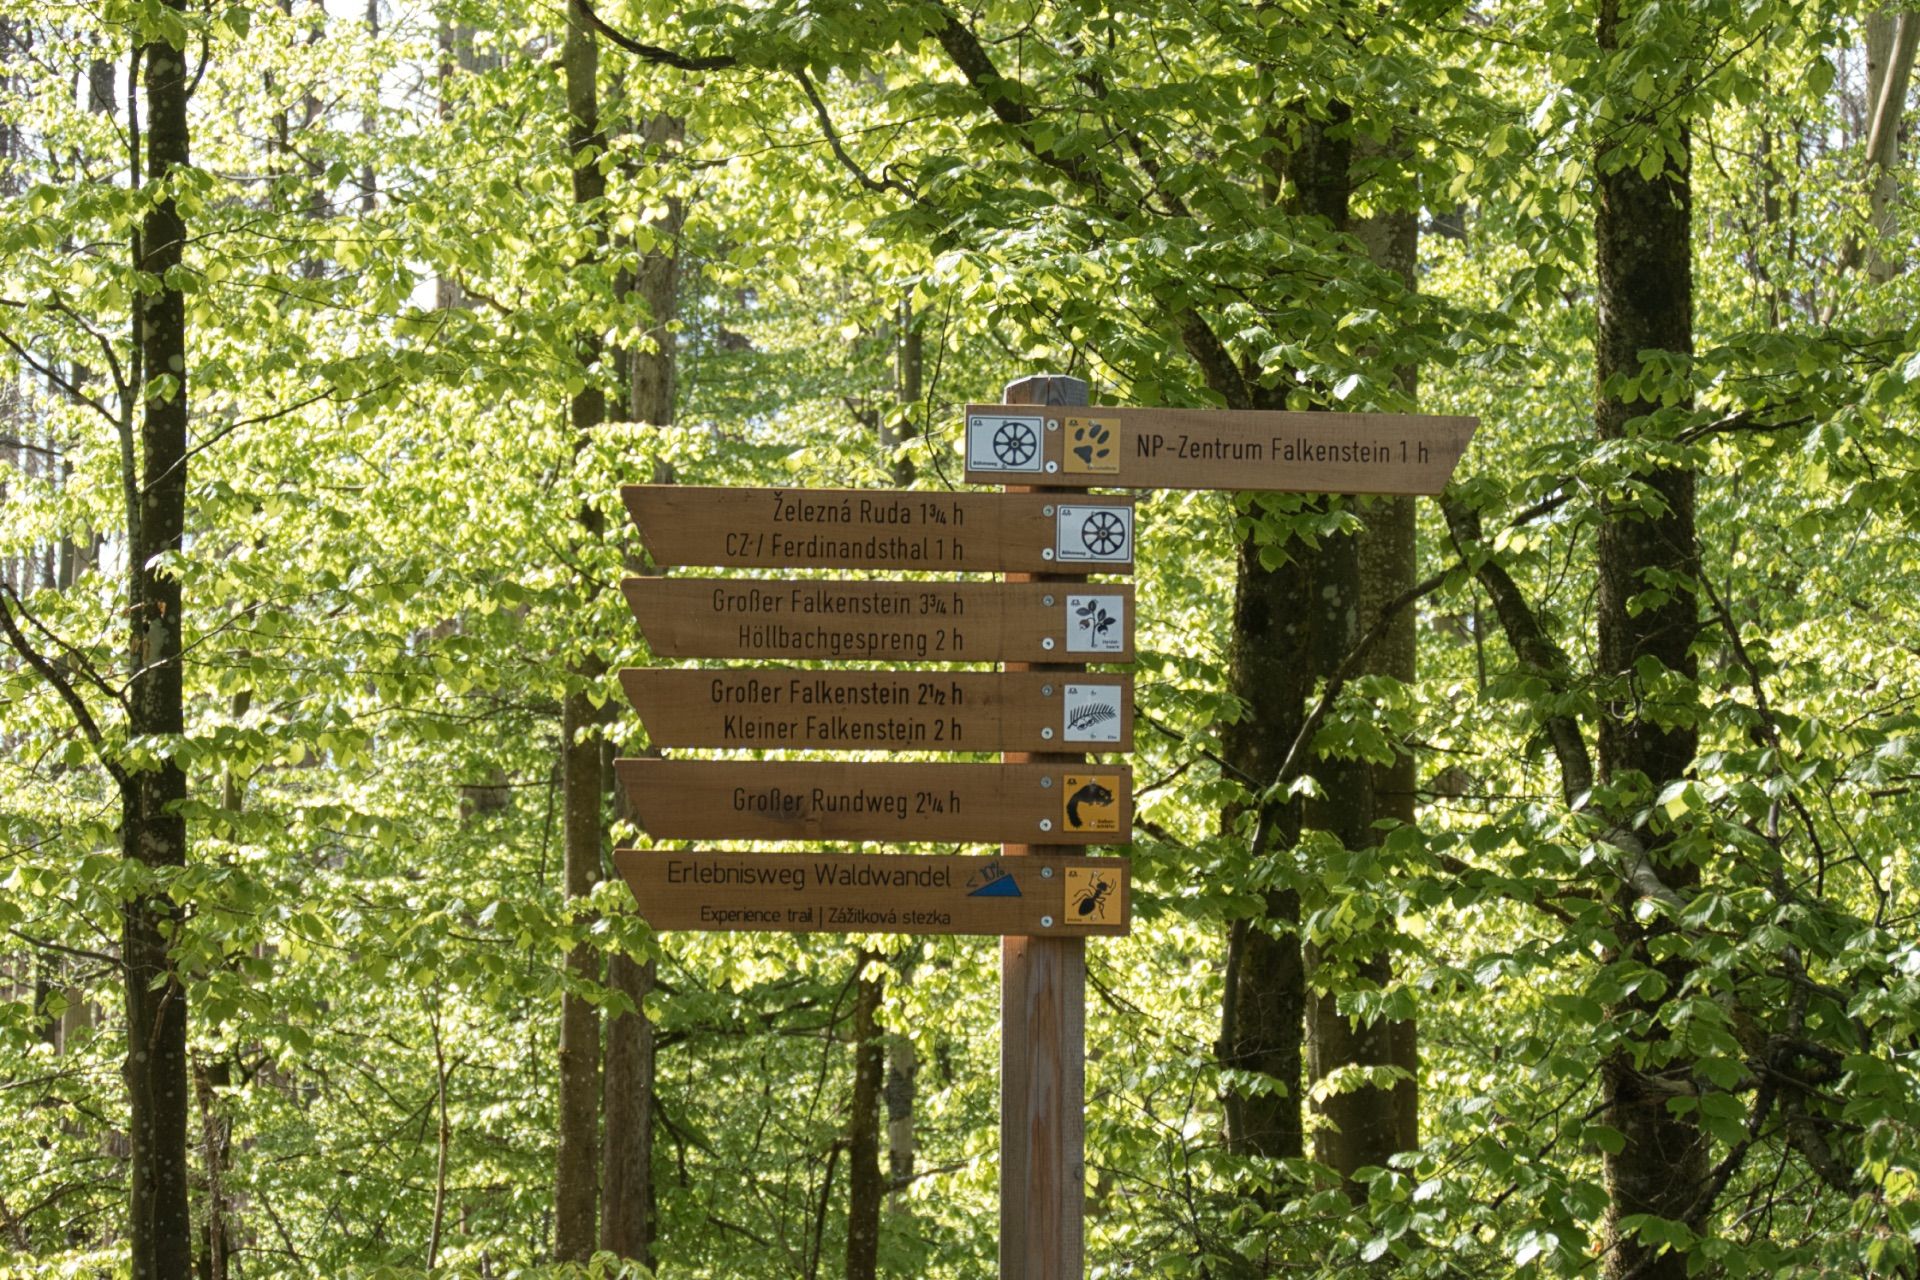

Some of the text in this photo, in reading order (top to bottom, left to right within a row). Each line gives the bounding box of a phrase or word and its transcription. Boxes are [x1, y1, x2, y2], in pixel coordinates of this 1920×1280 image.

[1137, 434, 1429, 465] NP-Zentrum Falkenstein 1 h
[773, 489, 852, 524] Železná
[859, 500, 911, 525] Ruda
[952, 502, 964, 527] h
[771, 533, 929, 561] Ferdinandsthal
[935, 539, 943, 561] 1
[952, 537, 964, 561] h
[712, 589, 784, 613] Großer
[791, 589, 911, 616] Falkenstein
[953, 592, 964, 617] h
[739, 625, 964, 657] Höllbachgespreng 2 h
[711, 679, 783, 704] Großer
[789, 680, 910, 705] Falkenstein
[951, 682, 963, 706] h
[724, 715, 962, 742] Kleiner Falkenstein 2 h
[733, 787, 805, 812] Großer
[812, 788, 908, 818] Rundweg
[949, 790, 961, 814] h
[667, 861, 952, 891] Erlebnisweg Waldwandel
[700, 905, 782, 927] Experience
[787, 906, 814, 924] trail
[827, 907, 897, 925] Zážitková
[902, 909, 951, 926] stezka
